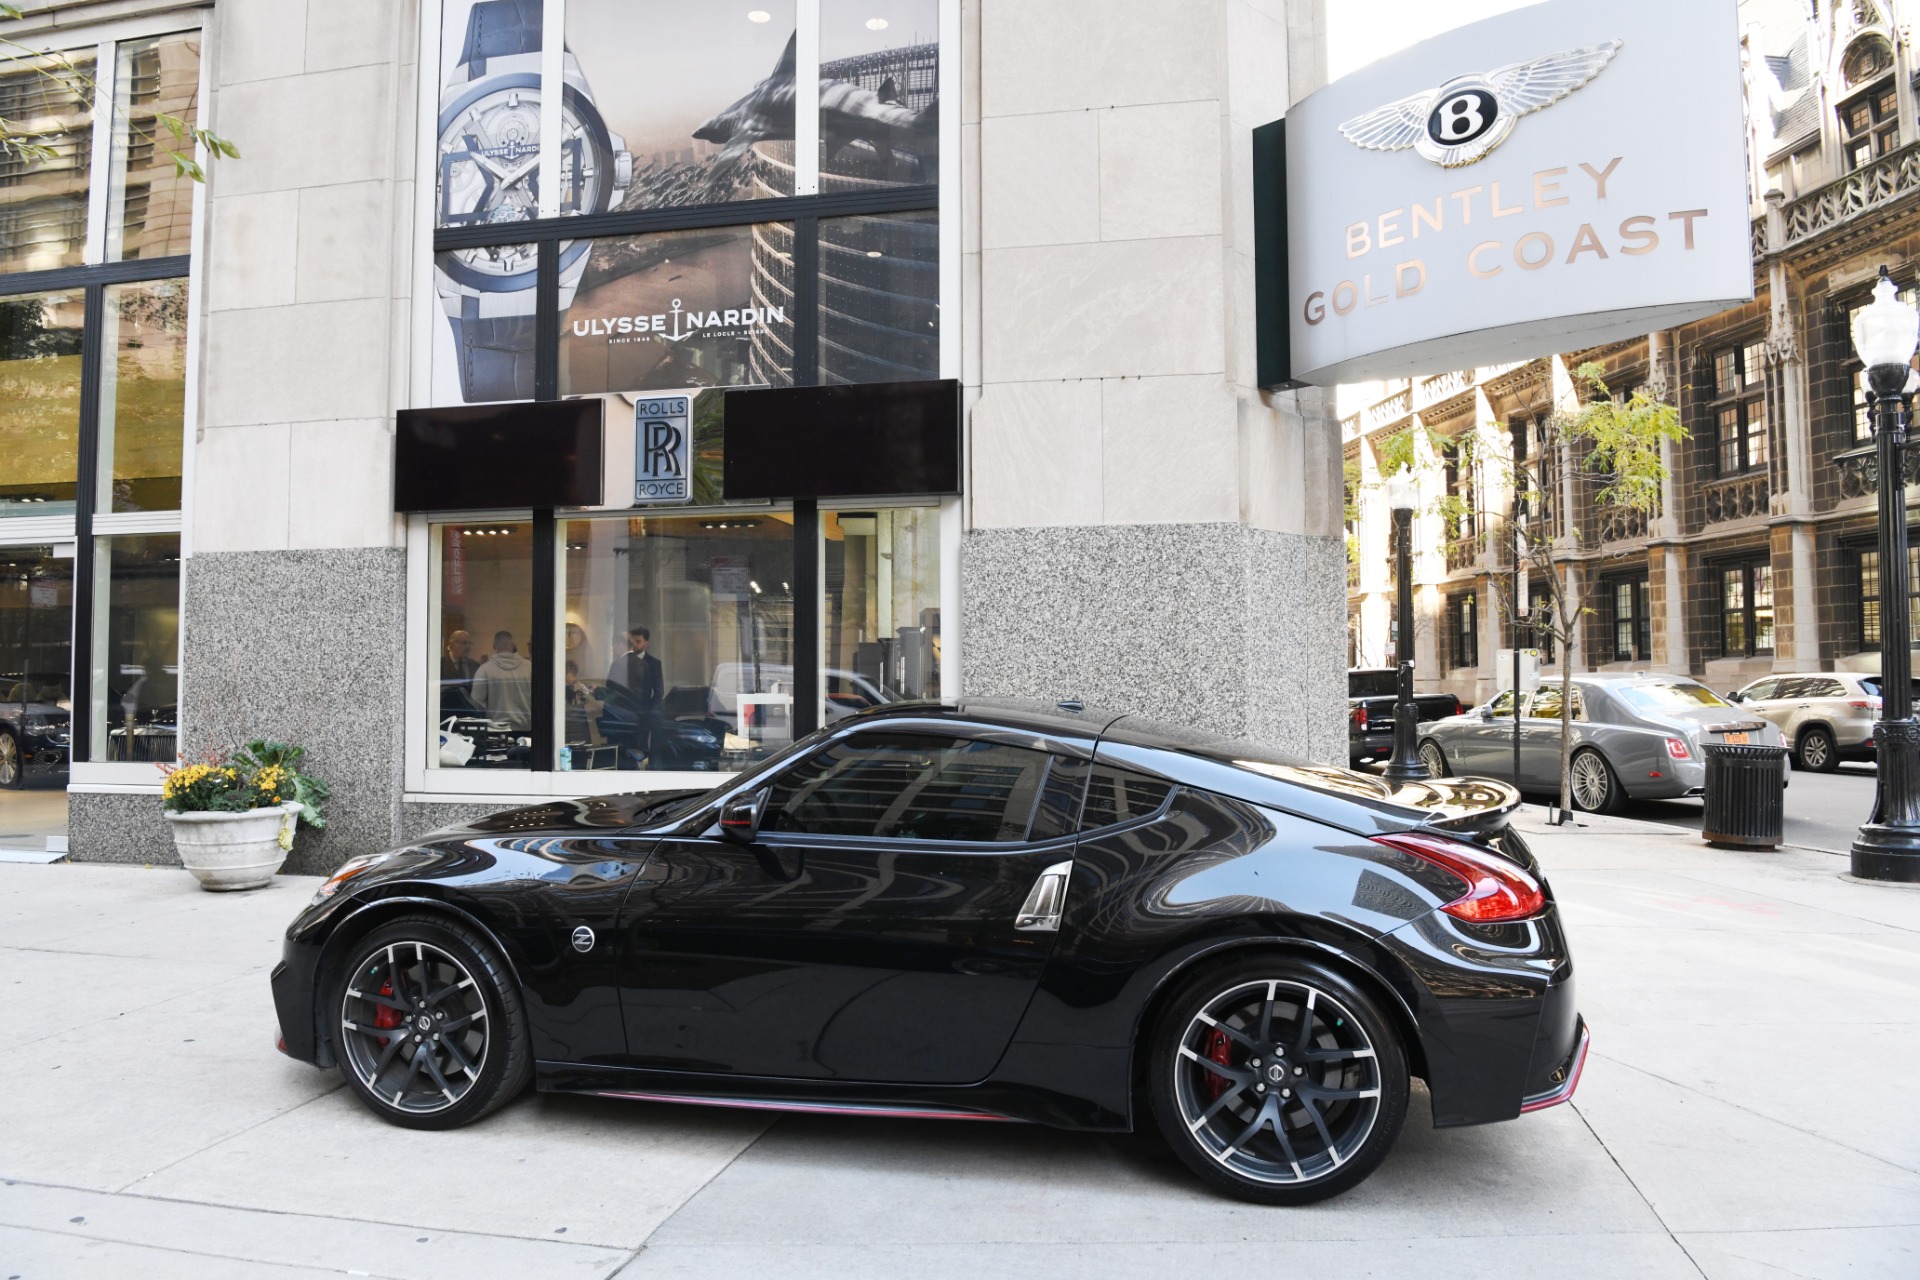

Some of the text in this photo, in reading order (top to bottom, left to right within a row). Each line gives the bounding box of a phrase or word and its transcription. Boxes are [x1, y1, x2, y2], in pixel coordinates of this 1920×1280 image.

[1439, 94, 1483, 140] B
[481, 148, 508, 157] ULYSSE
[1345, 156, 1623, 260] BENTLEY
[1303, 208, 1709, 326] GOLD COAST
[573, 306, 784, 336] ULYSSE NARDIN
[640, 401, 684, 415] ROLLS
[639, 483, 684, 496] ROYCE
